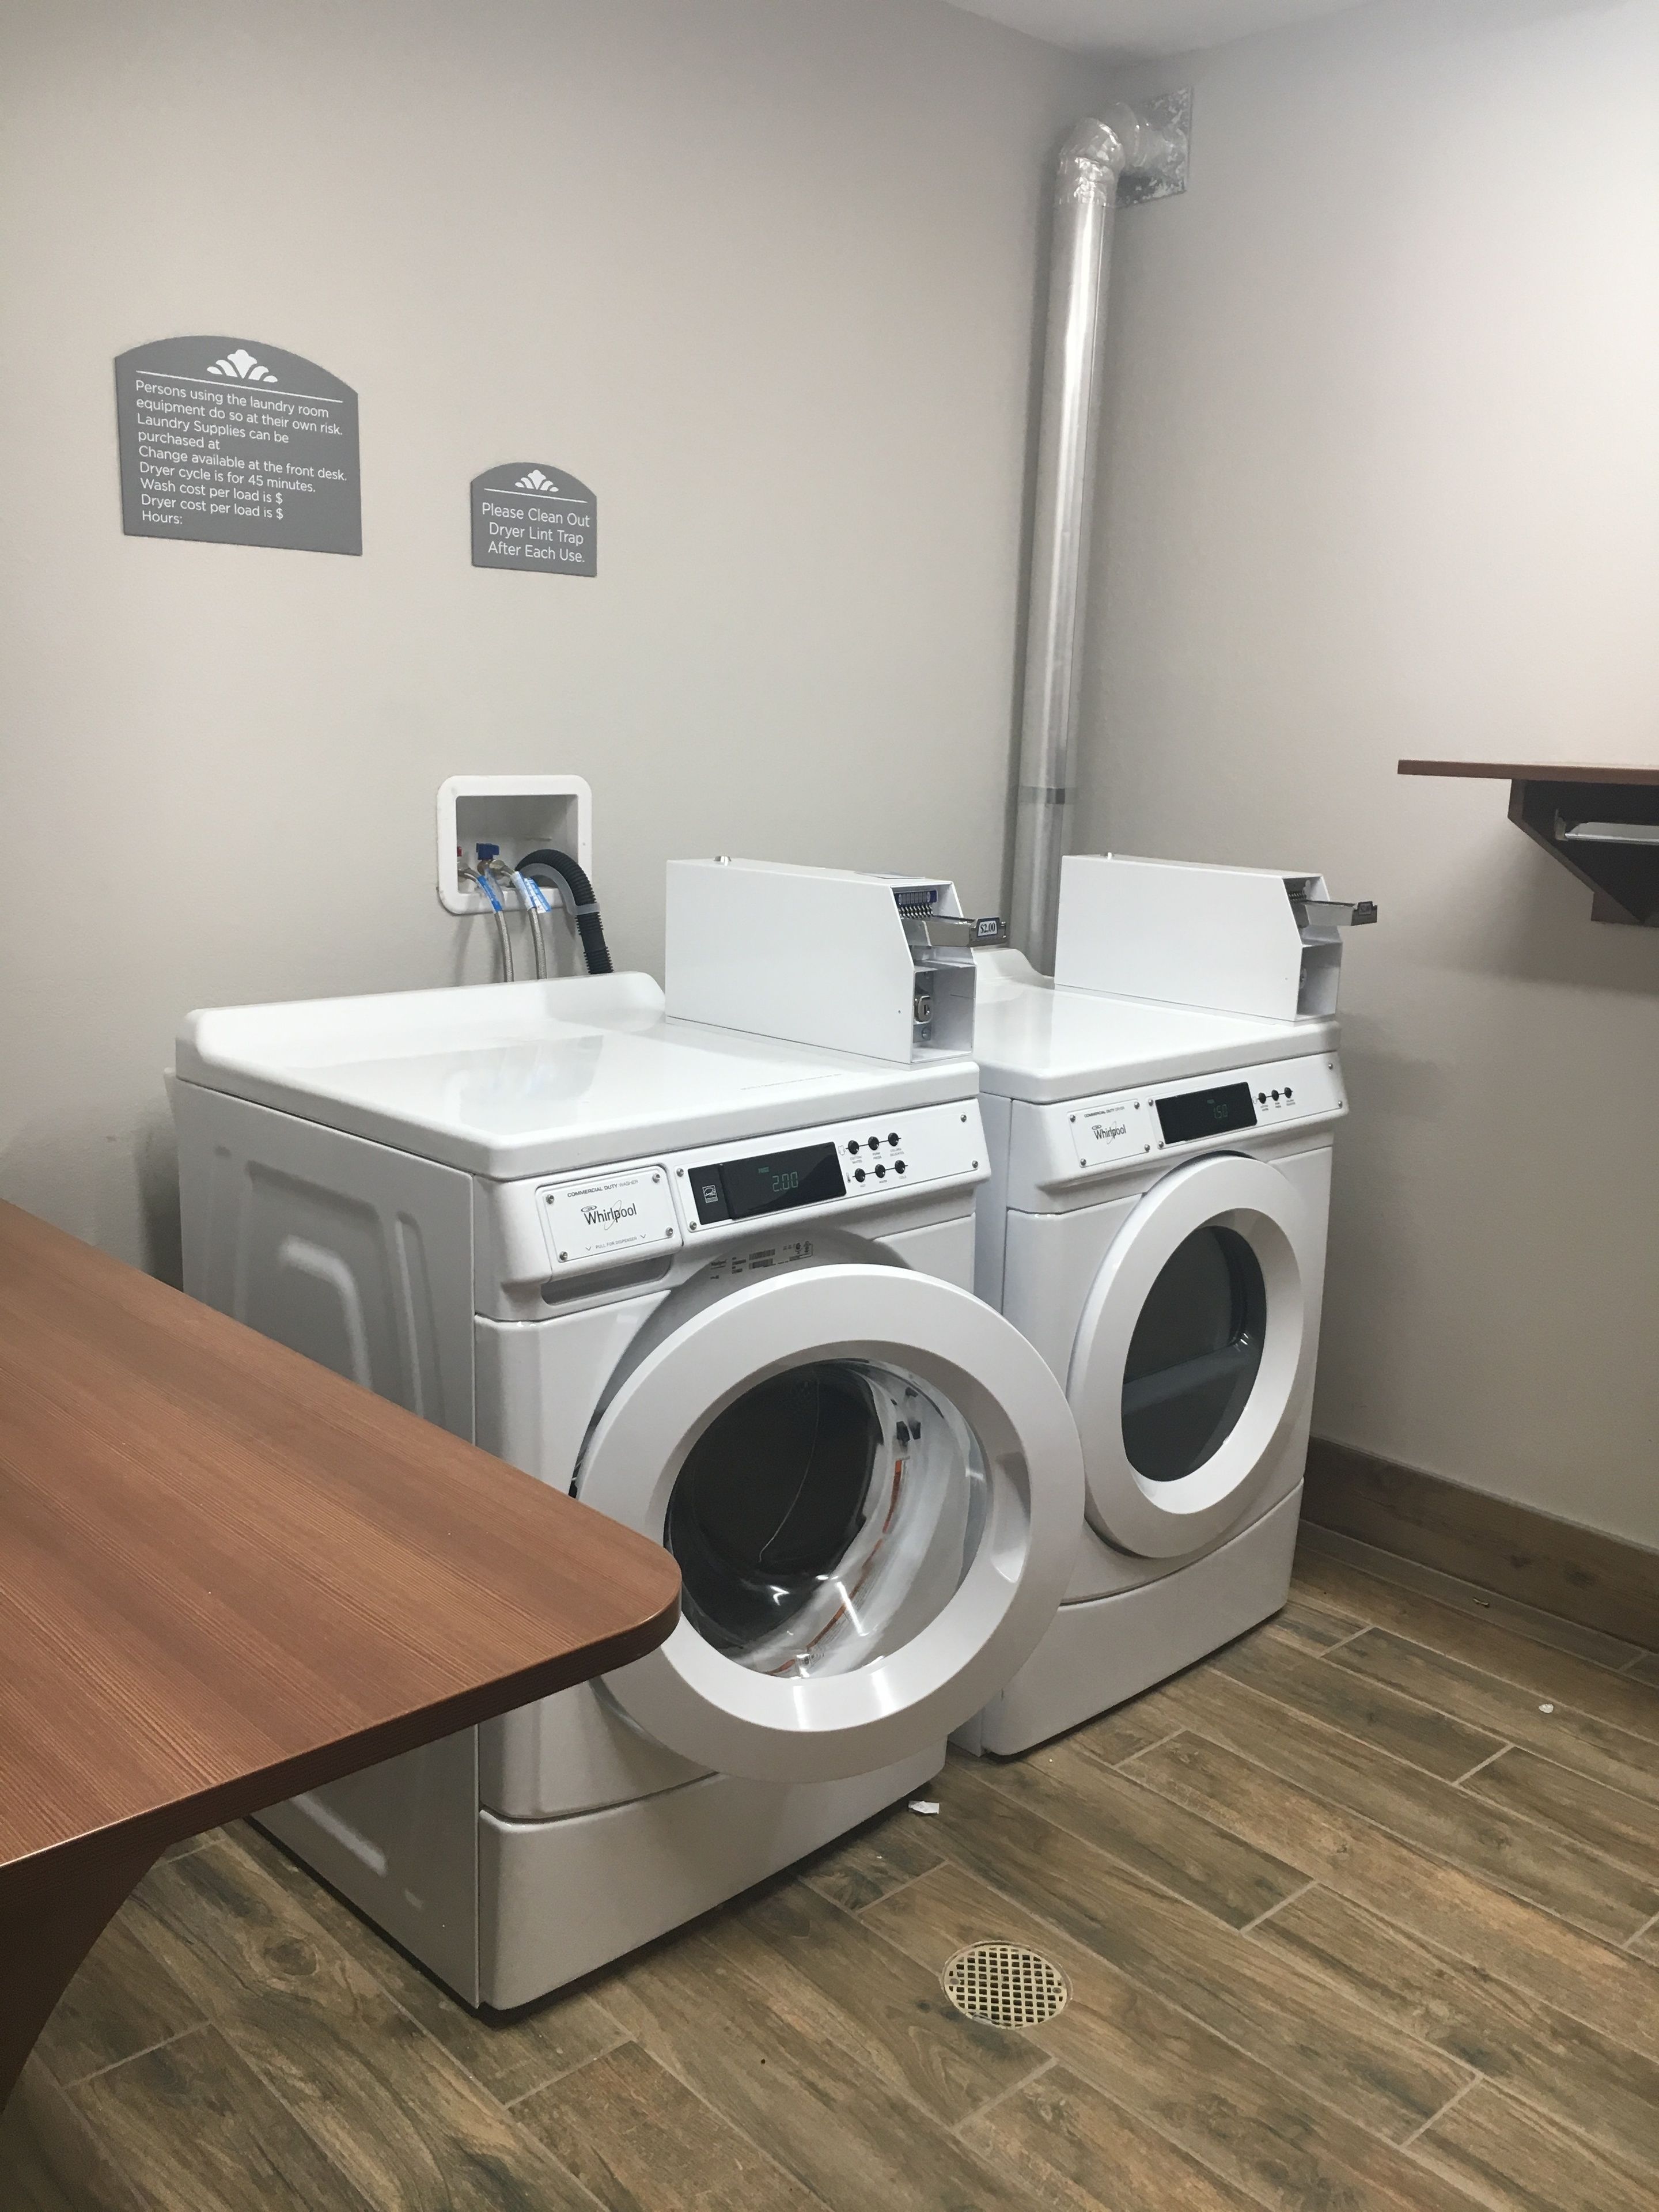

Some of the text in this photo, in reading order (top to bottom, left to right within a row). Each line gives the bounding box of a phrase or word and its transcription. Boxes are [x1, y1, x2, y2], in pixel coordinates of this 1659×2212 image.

[136, 380, 329, 418] Persons using the laundry room
[137, 399, 343, 435] equipment do so at their own risk.
[138, 412, 289, 443] Laundry Supplies can be
[138, 431, 221, 450] purchased at
[139, 445, 347, 481] Change available at the front desk.
[140, 461, 315, 493] Dryer cycle is for 45 minutes.
[140, 478, 283, 505] Wash cost per load is $
[142, 494, 283, 520] Dryer cost per load is $
[142, 510, 183, 524] Hours:
[482, 502, 590, 527] Please Clean Out
[490, 522, 584, 546] Dryer Lint Trap
[488, 541, 585, 563] After Each Use.
[980, 923, 995, 933] $2.00
[1094, 1124, 1126, 1139] Whirlpool
[567, 1187, 603, 1198] COMMERCIAL
[772, 1172, 798, 1192] 2.00
[584, 1203, 637, 1225] Whirlpool
